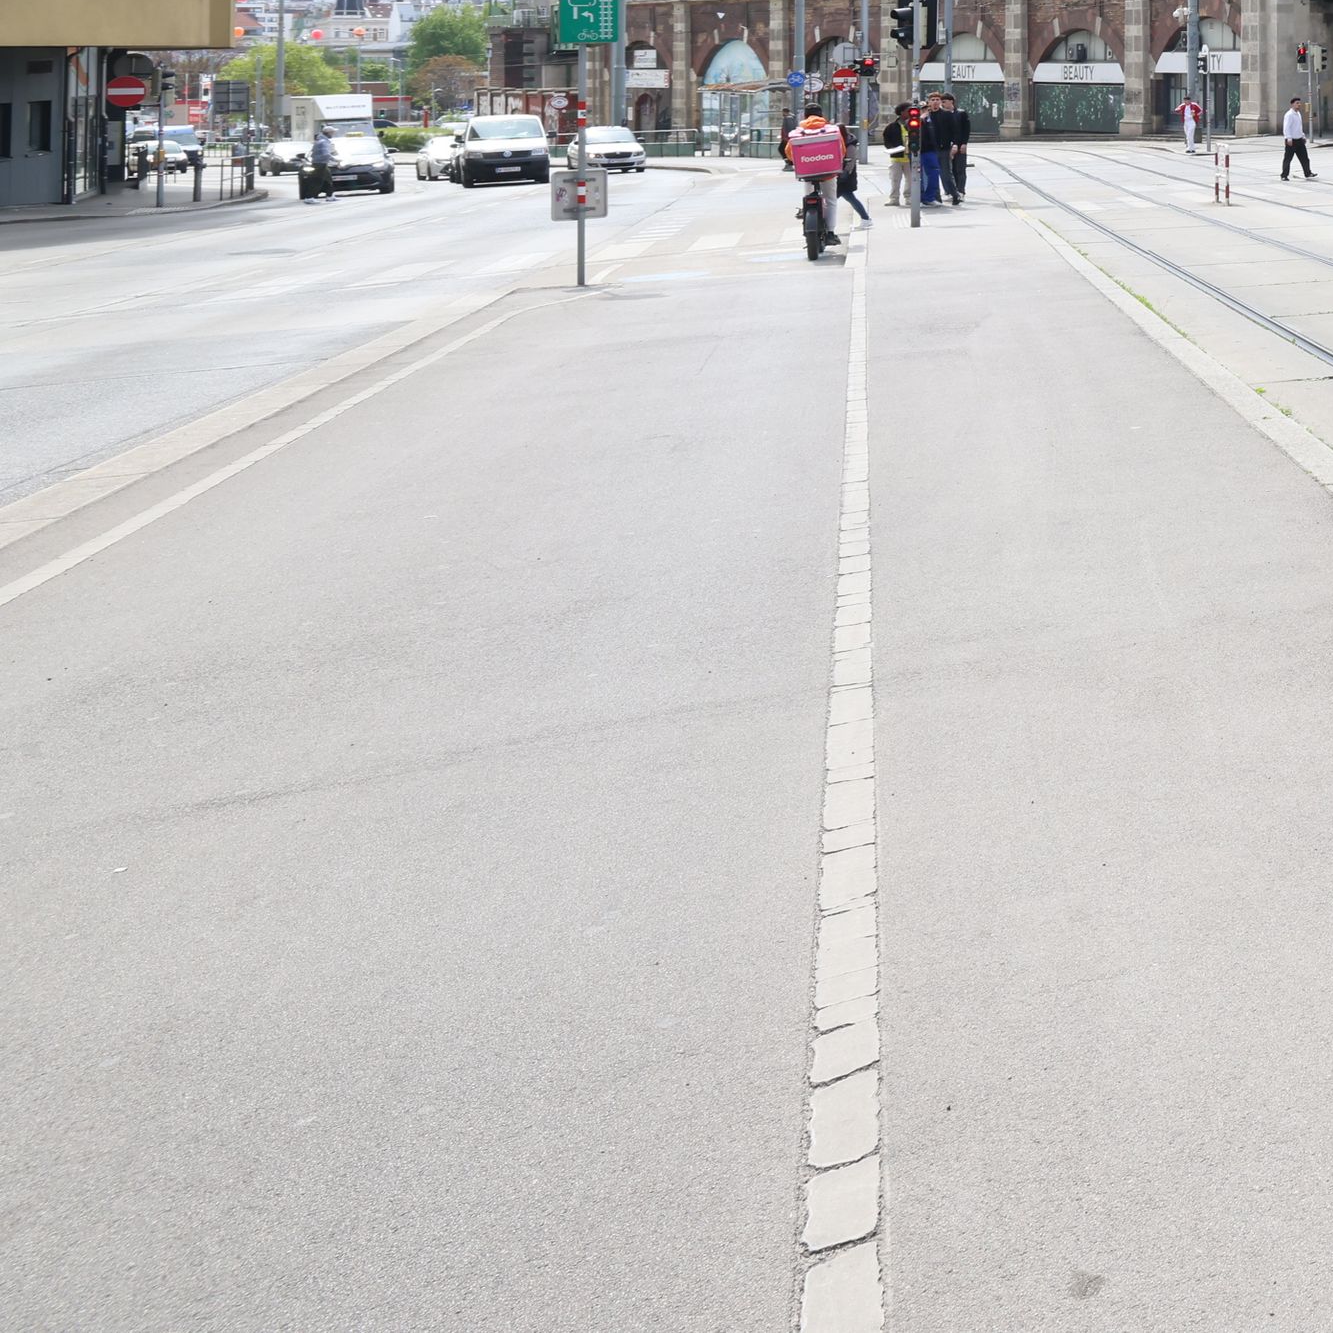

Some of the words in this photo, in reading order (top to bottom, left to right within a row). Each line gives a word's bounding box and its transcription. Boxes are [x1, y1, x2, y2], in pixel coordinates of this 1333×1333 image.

[951, 64, 976, 79] EAUTY
[1063, 65, 1095, 80] BEAUTY
[801, 152, 835, 163] foodora
